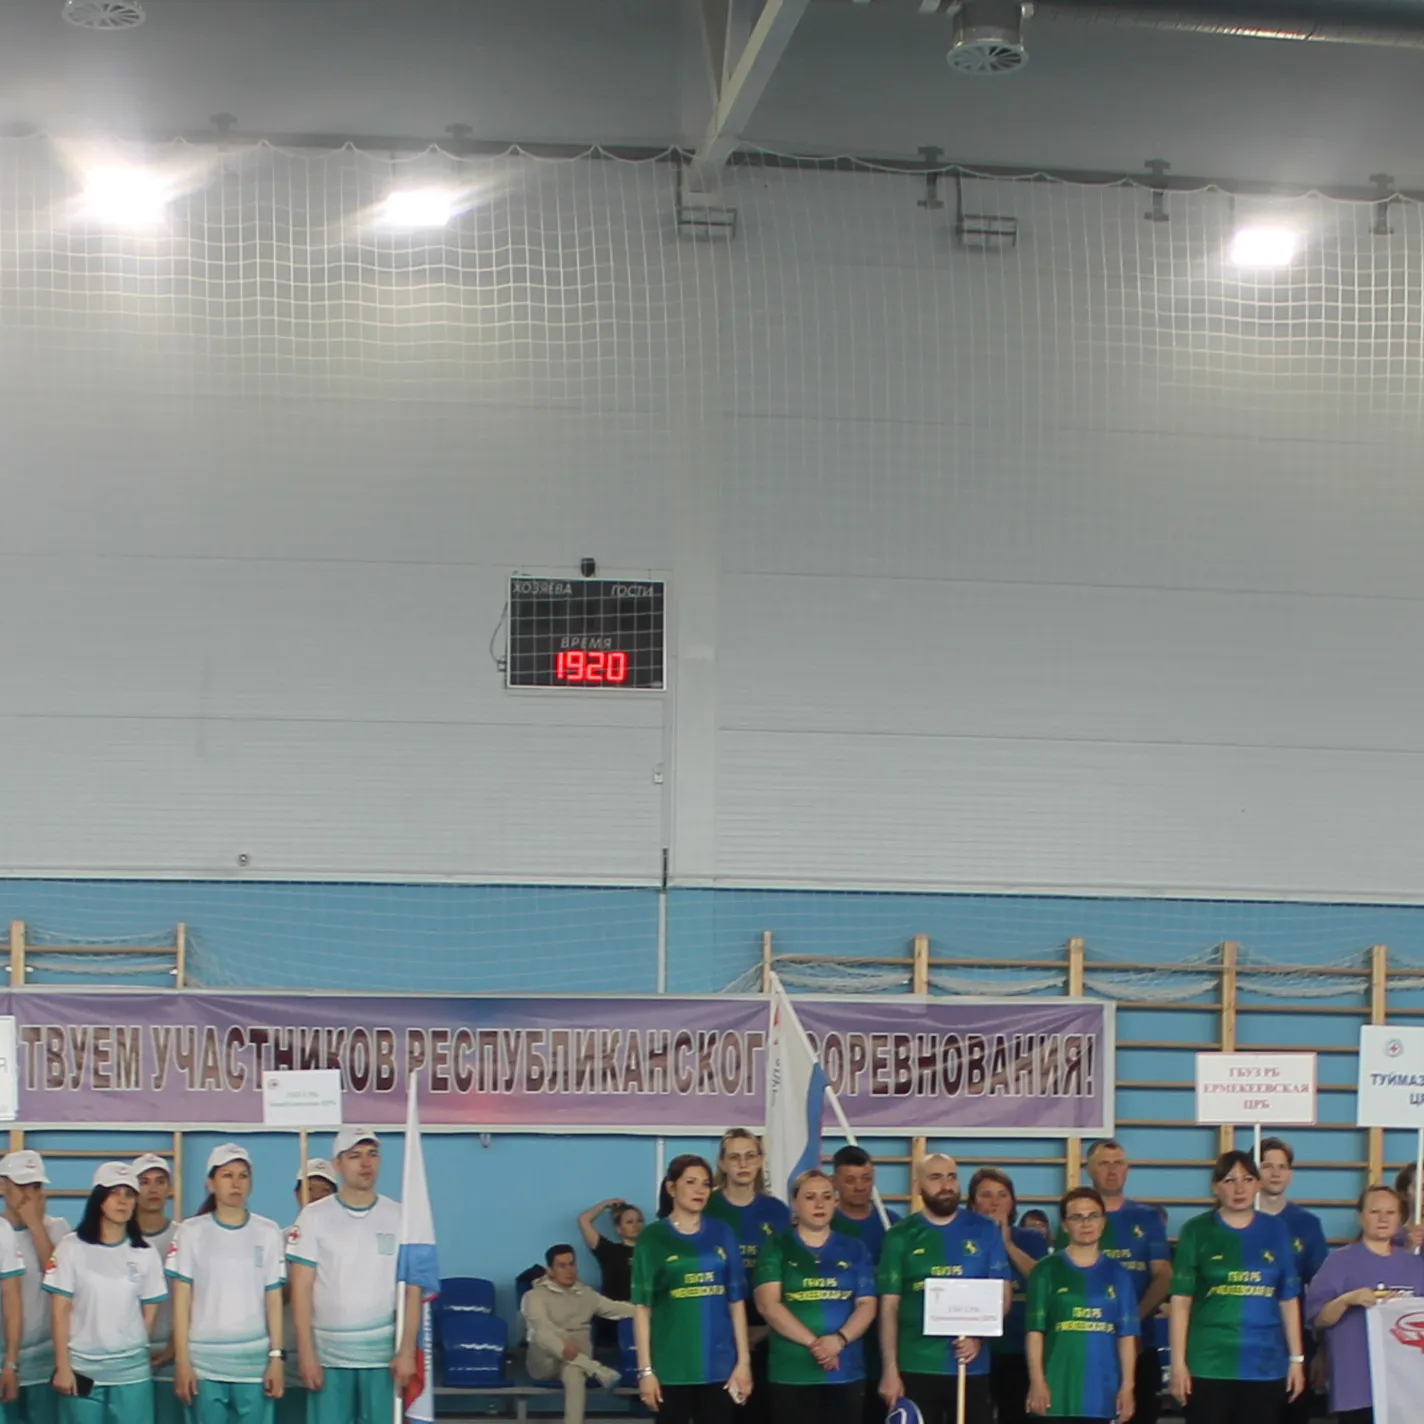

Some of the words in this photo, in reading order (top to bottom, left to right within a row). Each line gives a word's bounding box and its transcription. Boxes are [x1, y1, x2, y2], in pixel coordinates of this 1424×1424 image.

[513, 582, 573, 595] ХОЗЯЕВА
[611, 585, 654, 597] ГОСТИ
[561, 637, 612, 649] ВРЕМЯ
[556, 651, 628, 681] 1920
[16, 1024, 143, 1092] ТВУЕМ
[151, 1024, 398, 1093] УЧАСТНИКОВ
[405, 1027, 768, 1096] РЕСПУБЛИКАНСКОГ
[1264, 1067, 1281, 1078] РБ
[1203, 1083, 1310, 1094] ЕРМЕКЕЕВСКАЯ
[1243, 1099, 1270, 1110] ЦРБ
